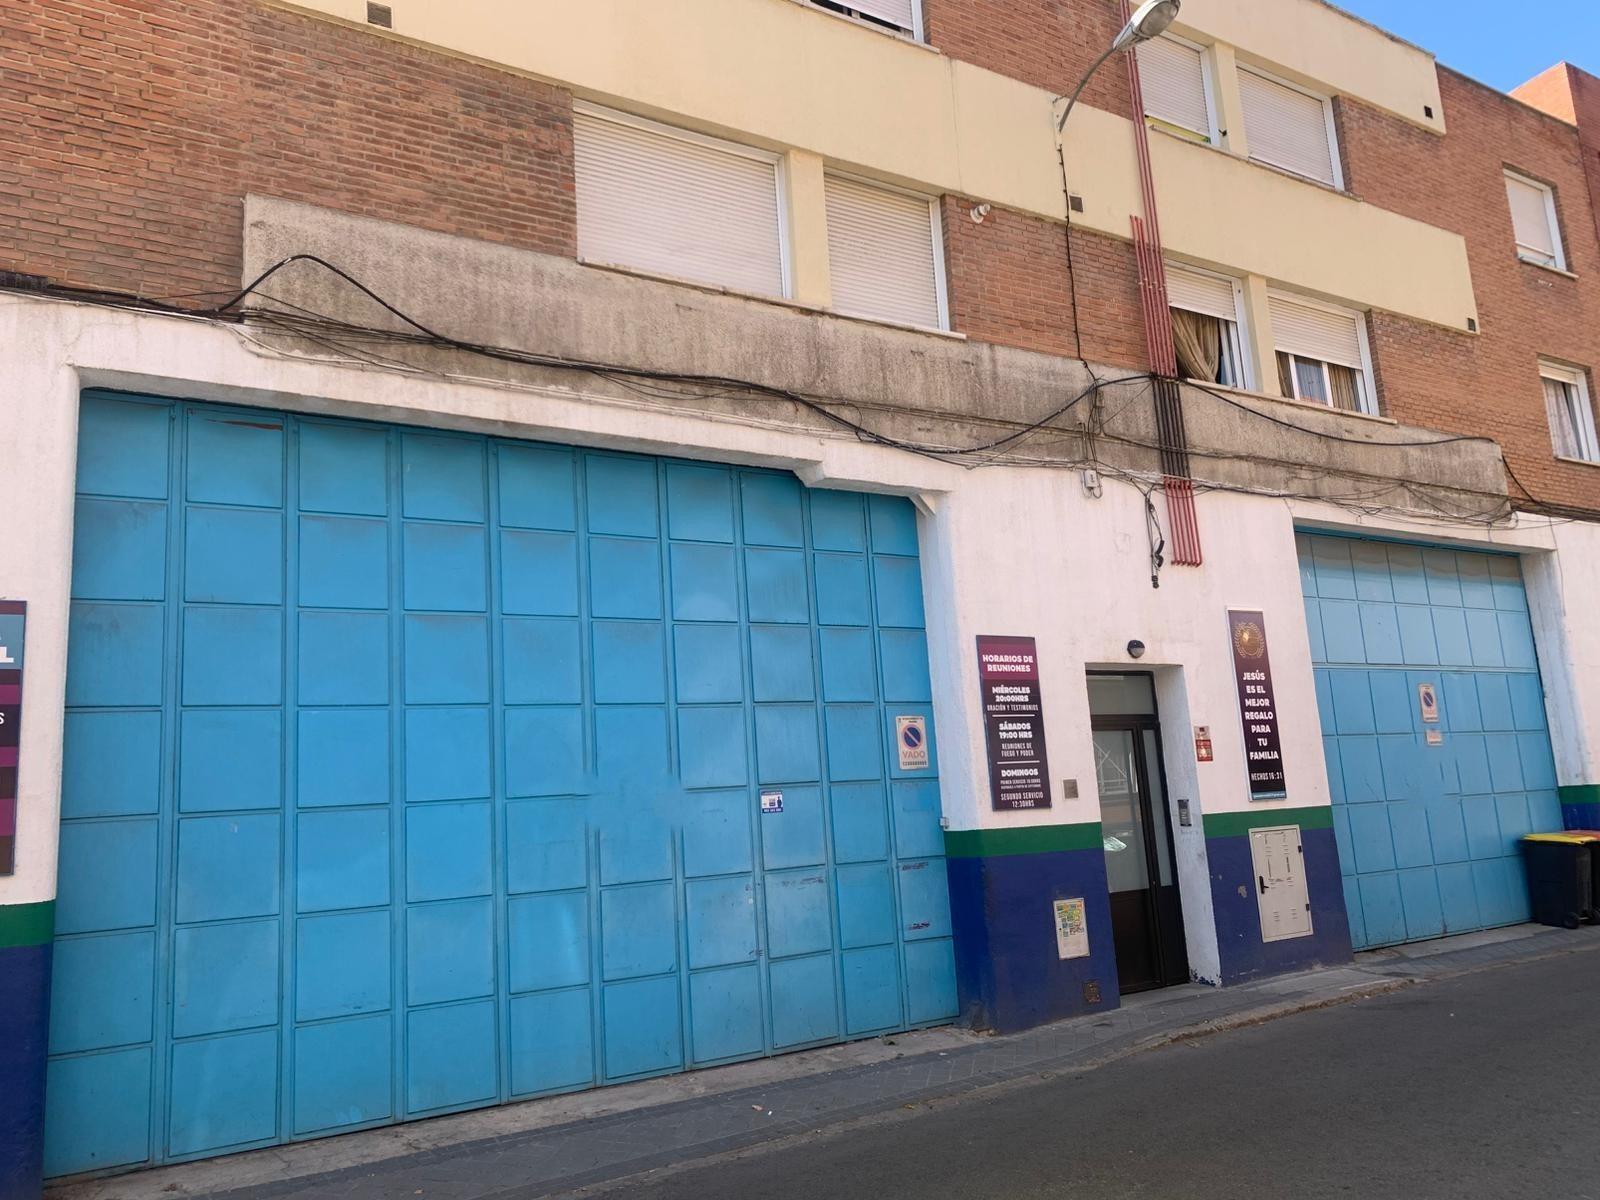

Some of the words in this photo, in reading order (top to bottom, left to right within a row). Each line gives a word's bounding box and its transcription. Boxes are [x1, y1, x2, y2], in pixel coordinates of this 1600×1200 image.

[1243, 670, 1266, 680] JESÚS
[992, 685, 1030, 694] MIÉRCOLES
[1244, 712, 1273, 720] REGALO
[999, 722, 1031, 730] SÁBADOS
[1251, 725, 1271, 733] PARA
[1257, 738, 1268, 746] TU
[1250, 751, 1279, 760] FAMILIA
[1001, 768, 1038, 777] DOMINGOS
[1022, 792, 1044, 800] SERVICIO
